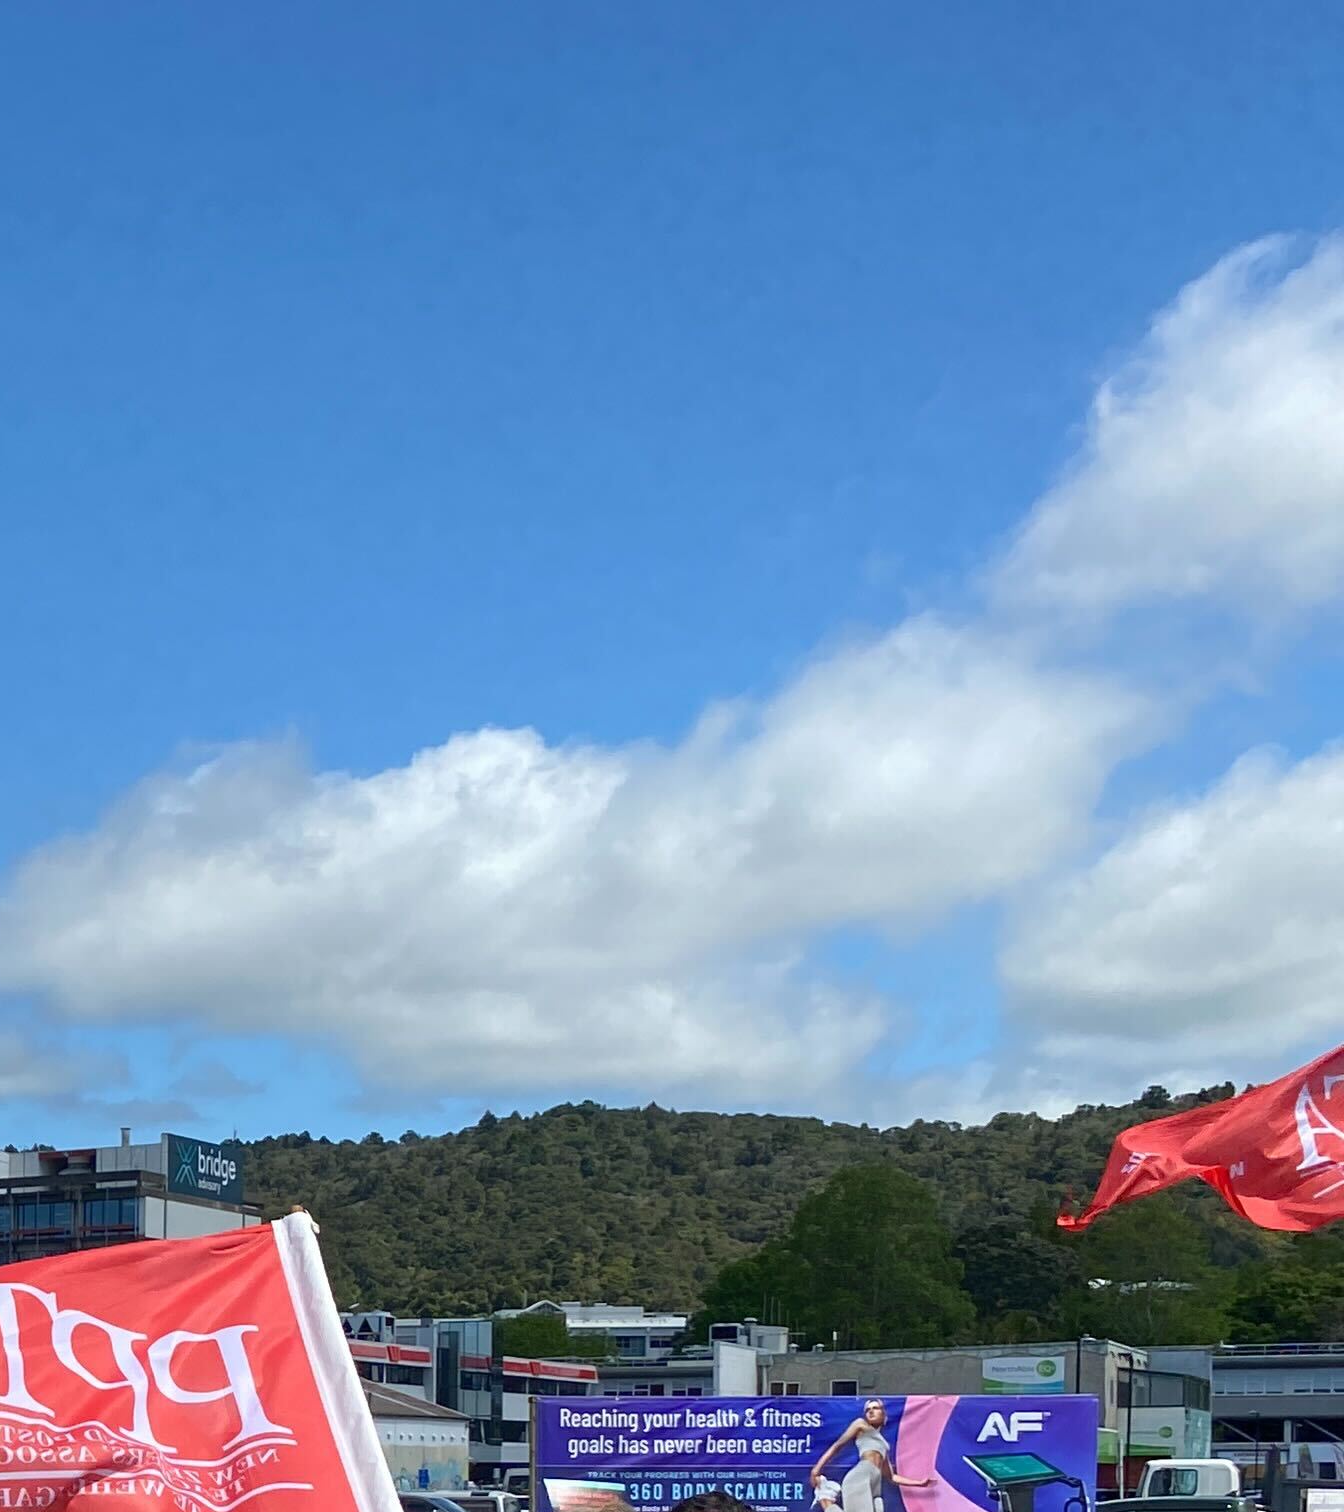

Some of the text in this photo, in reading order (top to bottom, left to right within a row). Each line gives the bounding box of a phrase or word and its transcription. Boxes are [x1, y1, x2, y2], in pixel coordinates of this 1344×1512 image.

[198, 1145, 236, 1186] bridge
[560, 1408, 822, 1433] Reaching your health & fitness
[976, 1411, 1043, 1443] AF
[568, 1434, 811, 1458] goals has never been easier!
[587, 1471, 616, 1479] TRACK
[619, 1471, 643, 1479] YOUR
[644, 1471, 690, 1479] PROGRESS
[692, 1471, 715, 1479] WITH
[716, 1471, 735, 1479] OUR
[630, 1483, 663, 1501] 360
[723, 1483, 804, 1501] SCANNER
